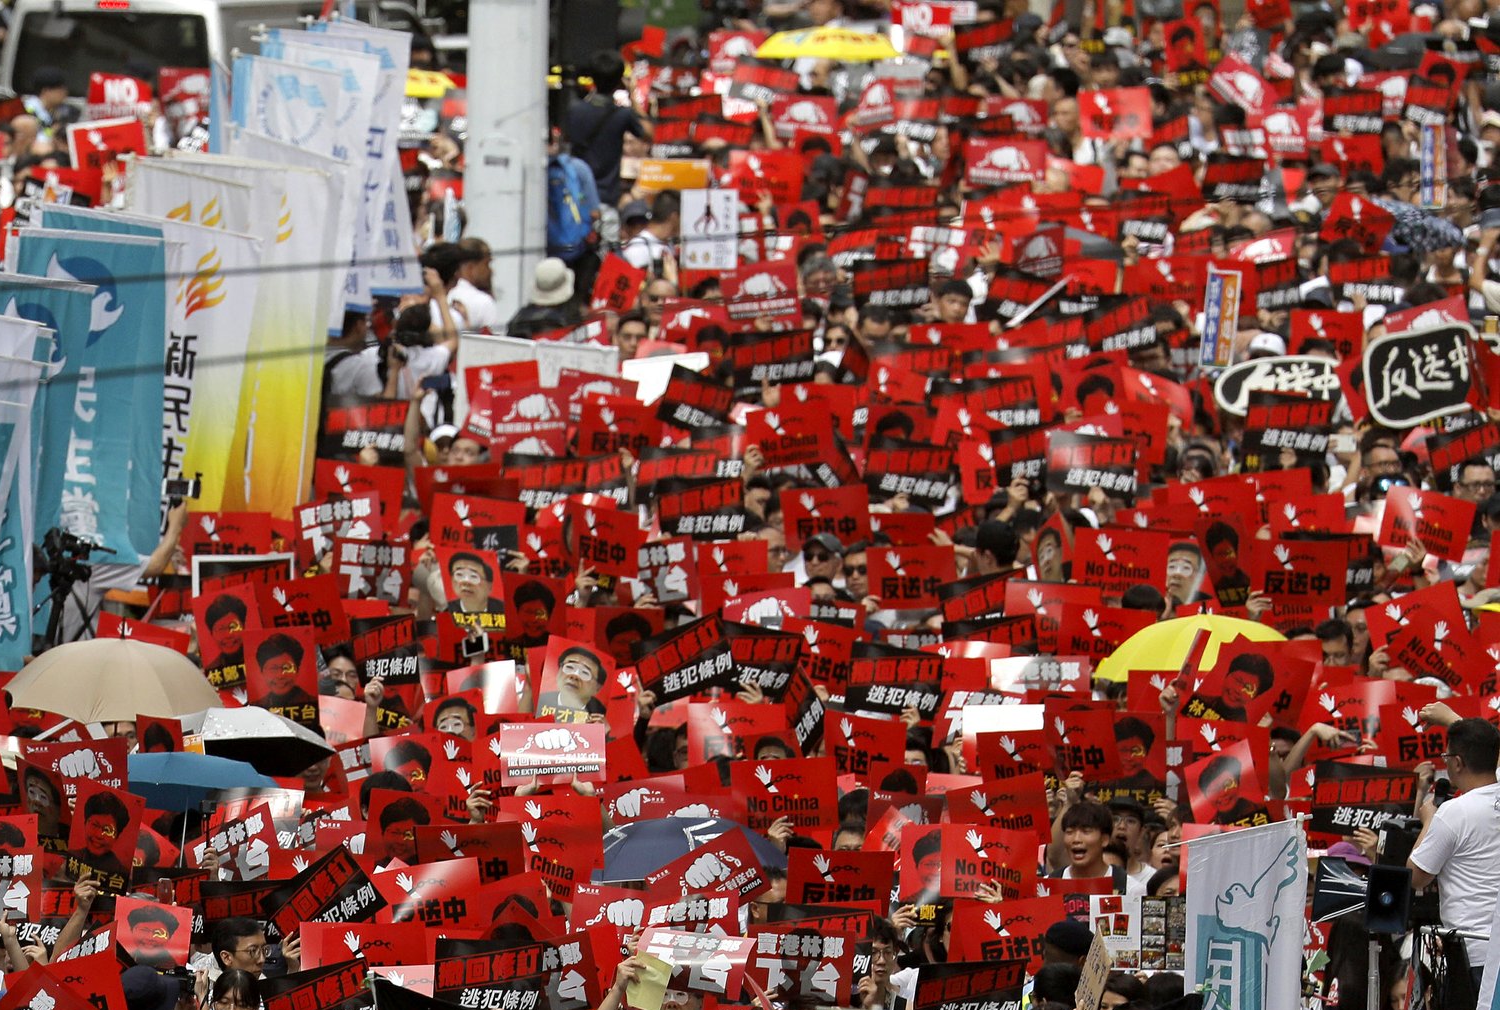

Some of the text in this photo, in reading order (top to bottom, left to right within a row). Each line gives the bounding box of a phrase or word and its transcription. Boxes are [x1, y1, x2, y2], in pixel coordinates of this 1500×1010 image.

[1376, 337, 1468, 407] 反送中
[1260, 429, 1327, 452] 逃犯條例
[678, 515, 744, 534] 逃犯條例
[1085, 563, 1150, 579] No China
[1264, 571, 1330, 596] 反送中
[364, 654, 417, 679] 逃犯條例
[663, 650, 732, 692] 逃犯條例
[866, 686, 938, 709] 逃犯條例
[523, 765, 565, 776] EXTRADITION
[567, 764, 576, 772] TO
[578, 761, 599, 771] CHINA
[747, 794, 819, 812] No China
[955, 861, 1021, 882] No China
[648, 893, 729, 927] 賣港林鄭
[756, 932, 845, 958] 賣港林鄭
[756, 956, 841, 996] 下台
